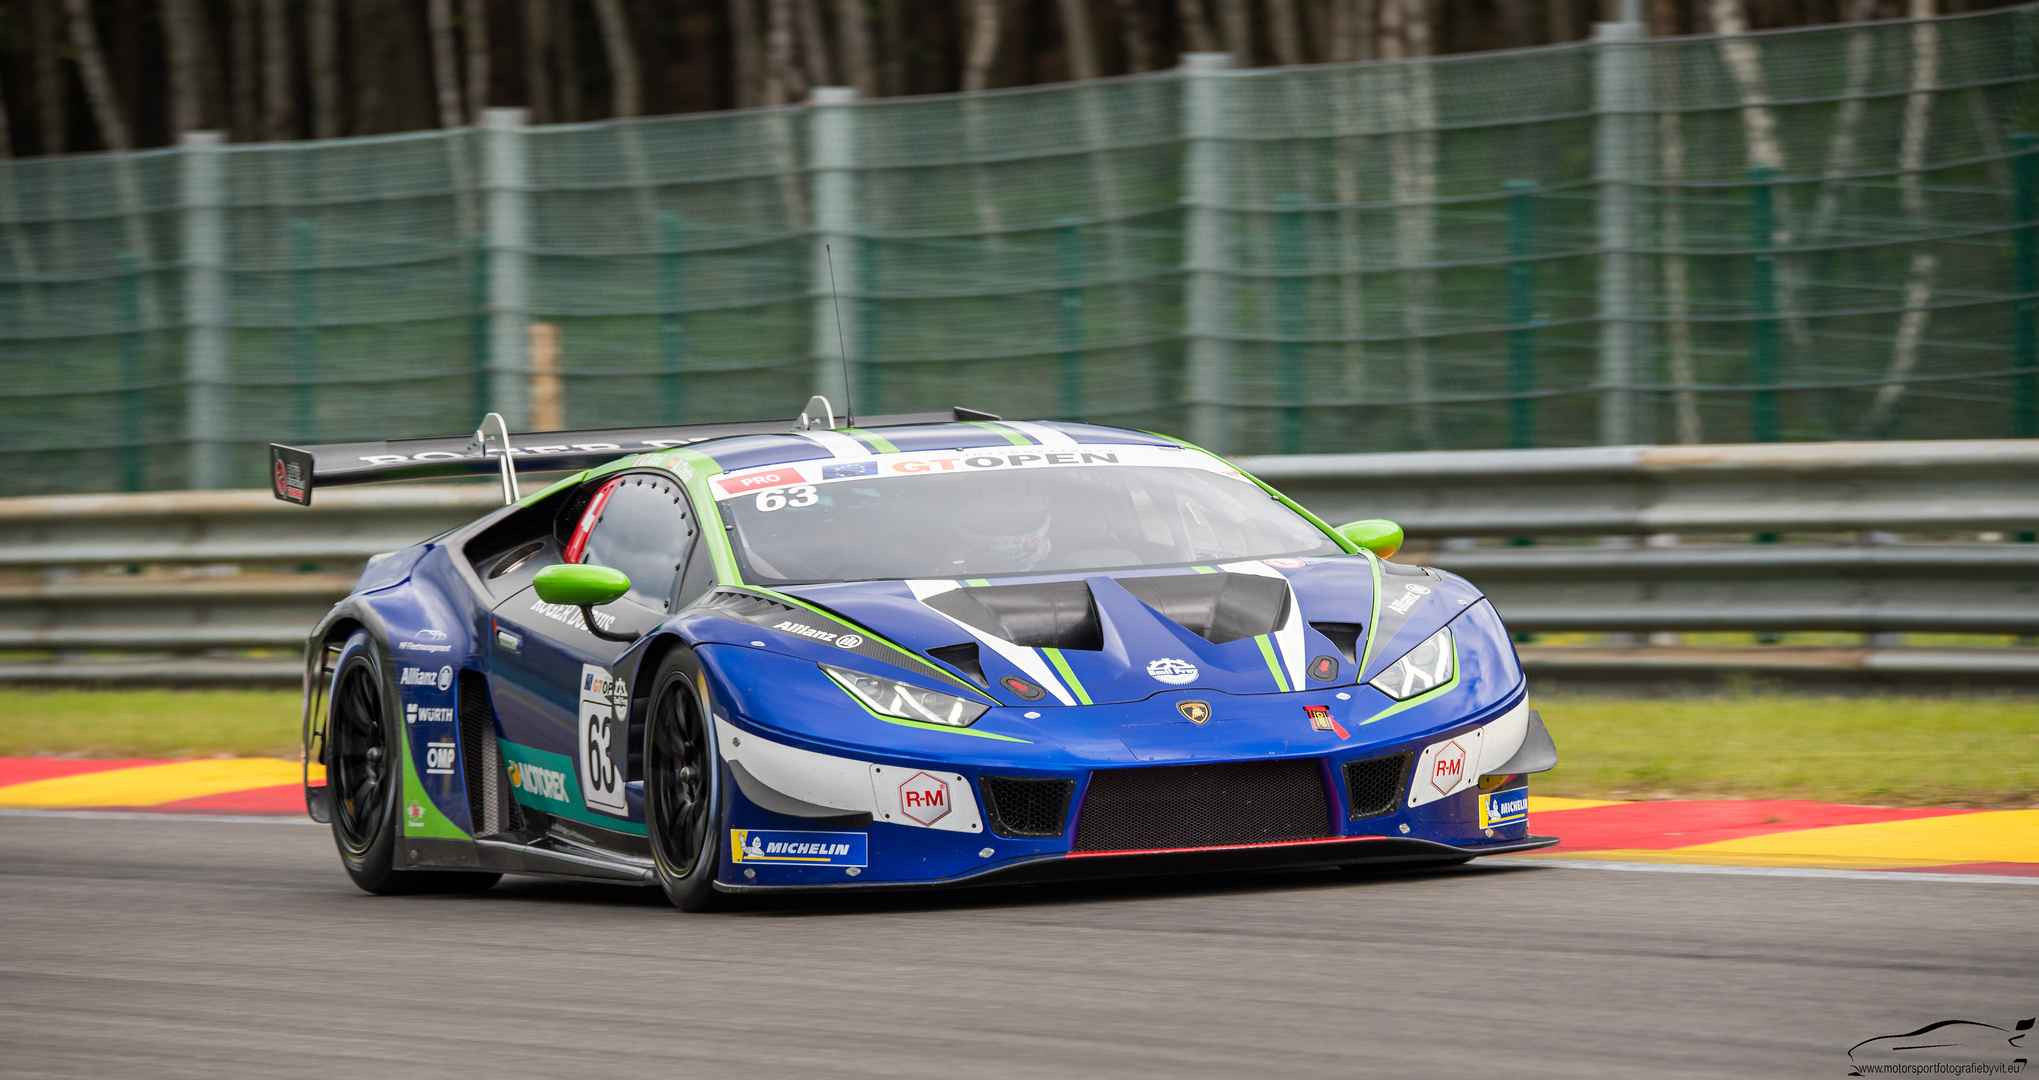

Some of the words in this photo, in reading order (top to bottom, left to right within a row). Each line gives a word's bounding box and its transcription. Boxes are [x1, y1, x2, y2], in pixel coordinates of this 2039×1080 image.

[741, 474, 781, 487] PRO
[756, 485, 819, 512] 63
[1388, 591, 1421, 615] Allianz
[772, 621, 838, 642] Allianz
[400, 667, 438, 686] Allianz
[427, 748, 455, 768] OMP
[588, 714, 615, 793] 63
[1436, 758, 1462, 777] R-M
[518, 762, 570, 803] MOTOREX
[906, 790, 944, 807] R-M
[766, 842, 850, 855] MICHELIN
